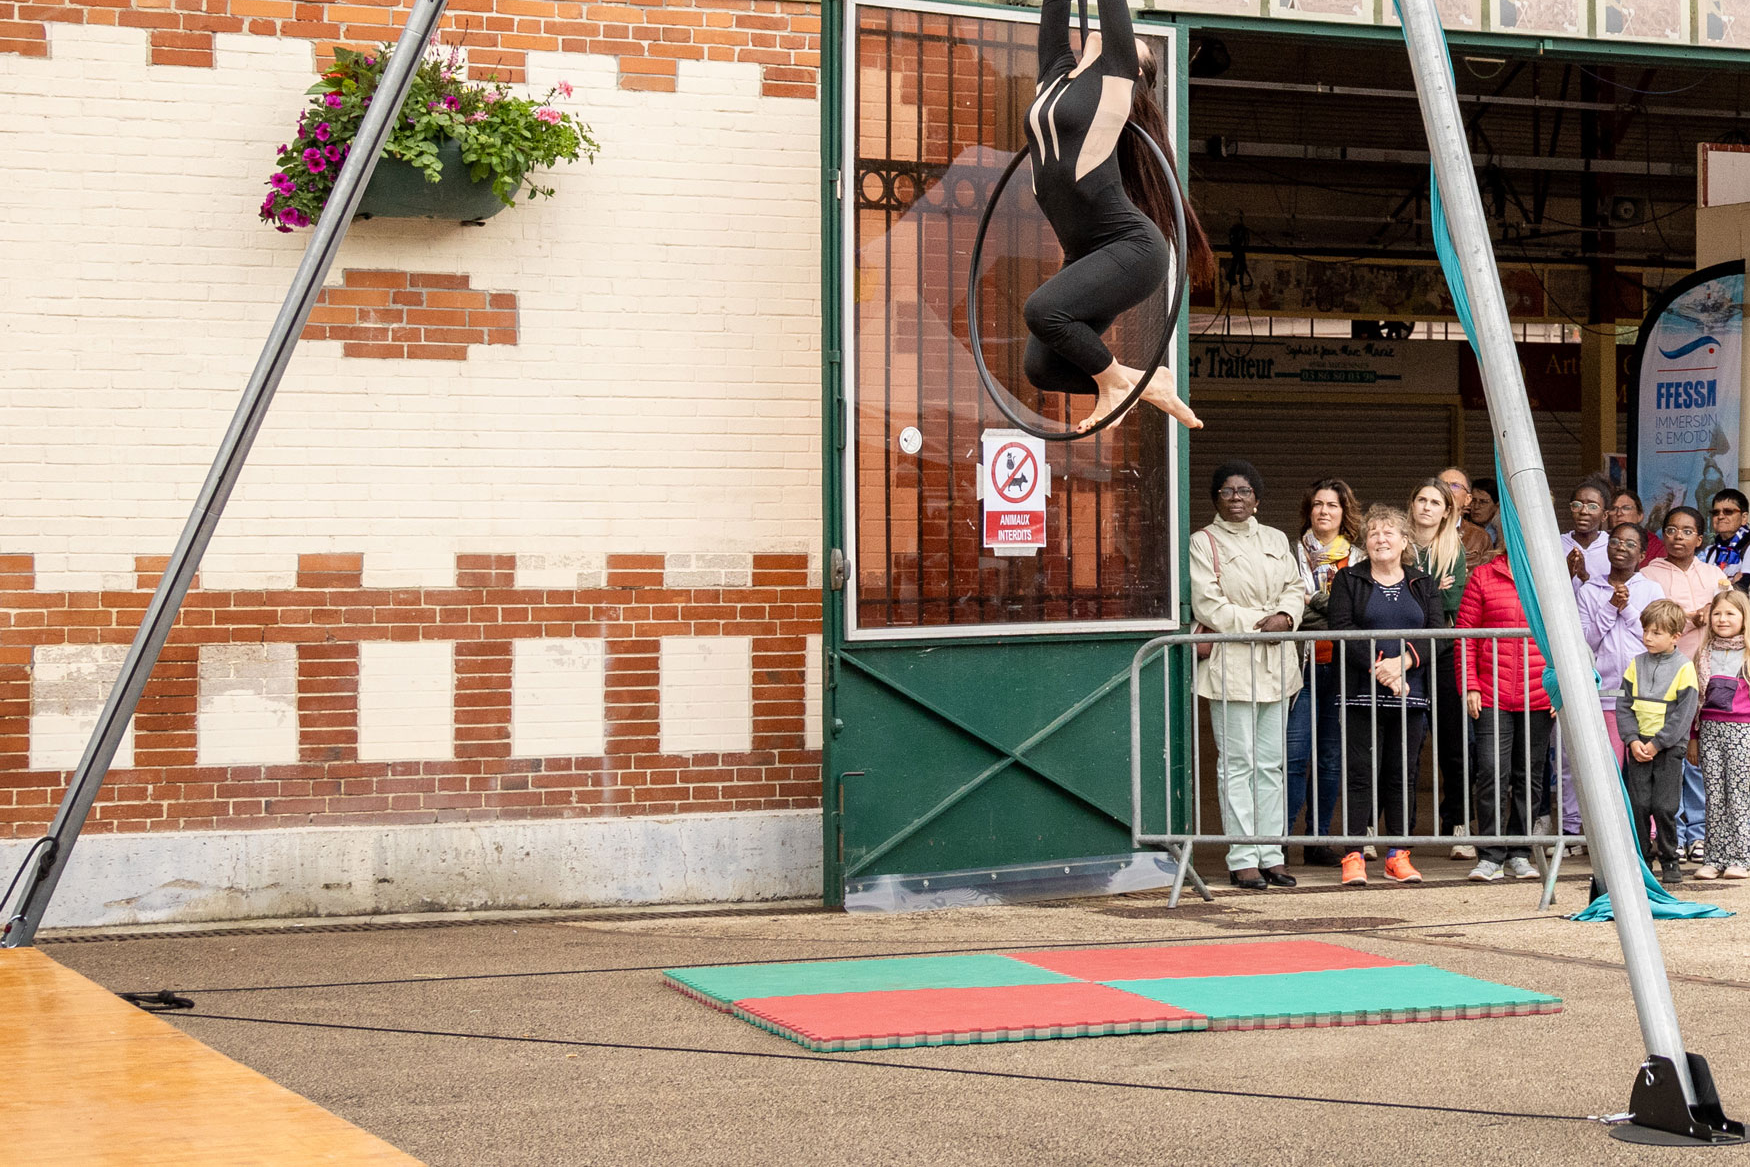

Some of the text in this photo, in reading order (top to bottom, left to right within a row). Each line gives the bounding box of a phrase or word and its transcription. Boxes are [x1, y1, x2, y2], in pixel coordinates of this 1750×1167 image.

[1205, 346, 1275, 379] Traiteur
[1655, 431, 1664, 445] &
[1000, 514, 1031, 525] ANIMAUX
[998, 529, 1033, 541] INTERDITS
